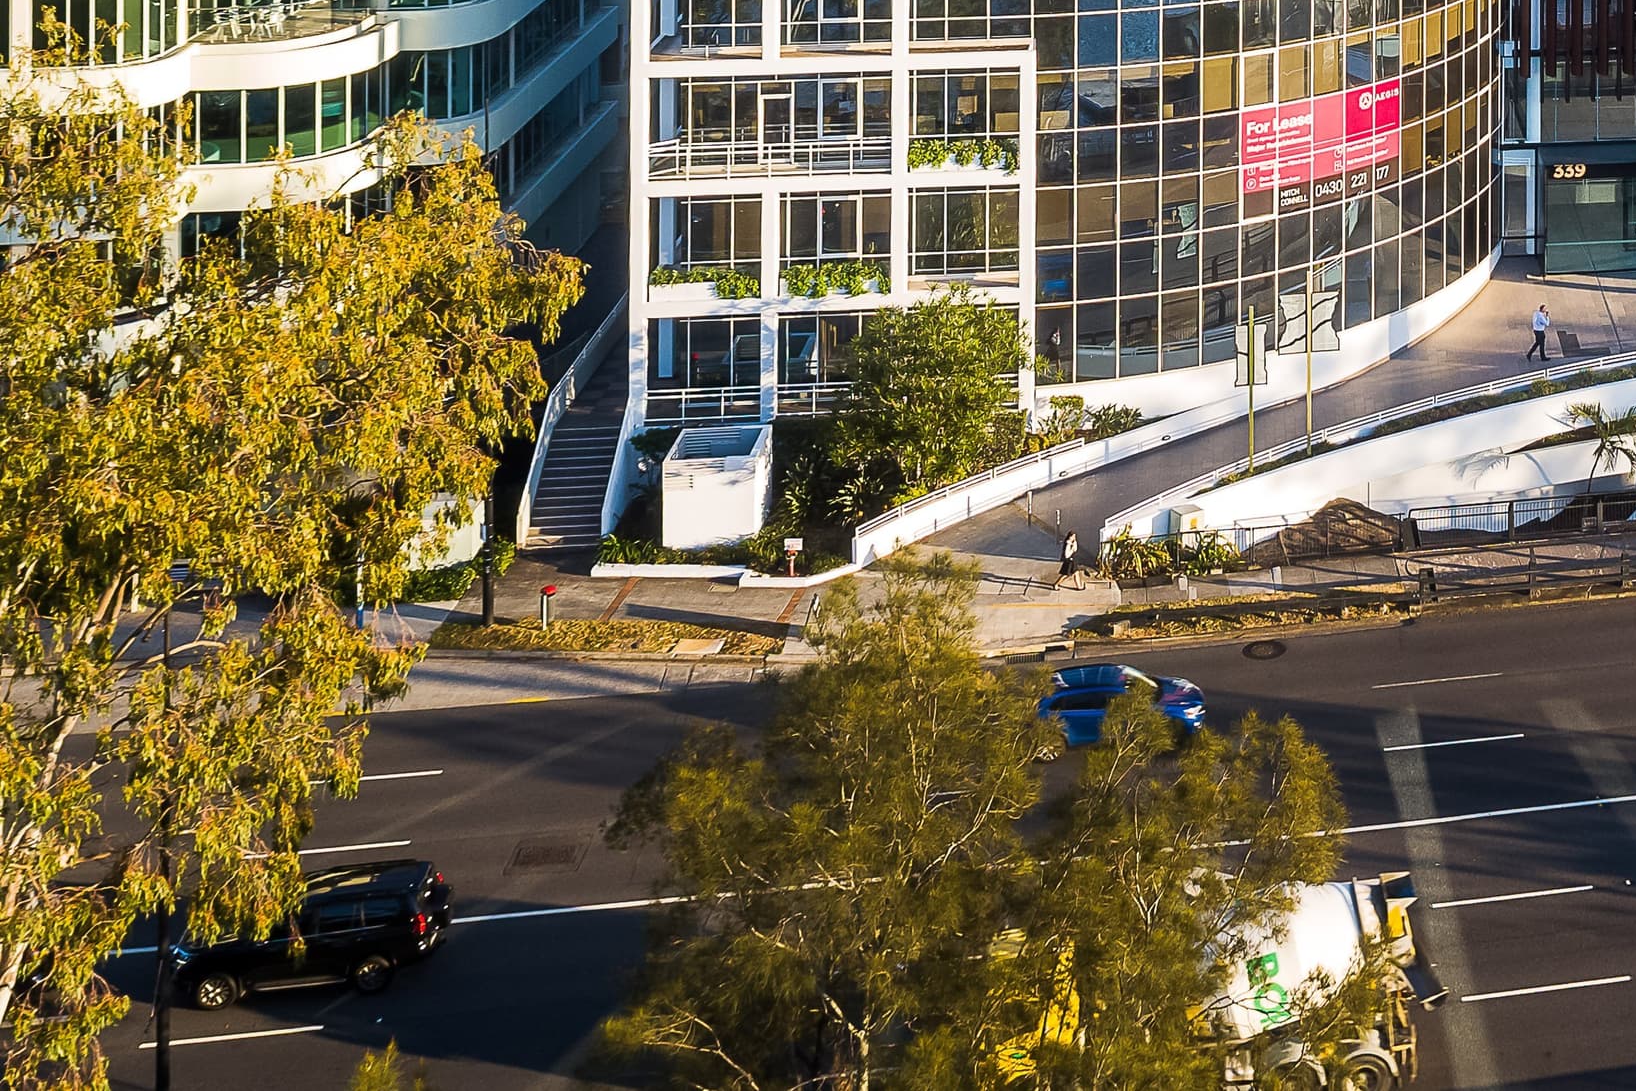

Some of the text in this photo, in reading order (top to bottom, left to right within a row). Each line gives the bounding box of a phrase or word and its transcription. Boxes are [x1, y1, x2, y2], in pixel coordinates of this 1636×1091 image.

[1375, 88, 1399, 102] AEGIS
[1246, 121, 1271, 136] For
[1272, 113, 1313, 132] Lease
[1553, 163, 1587, 178] 339
[1314, 179, 1344, 198] 0430
[1350, 172, 1368, 189] 221
[1375, 164, 1390, 181] 177
